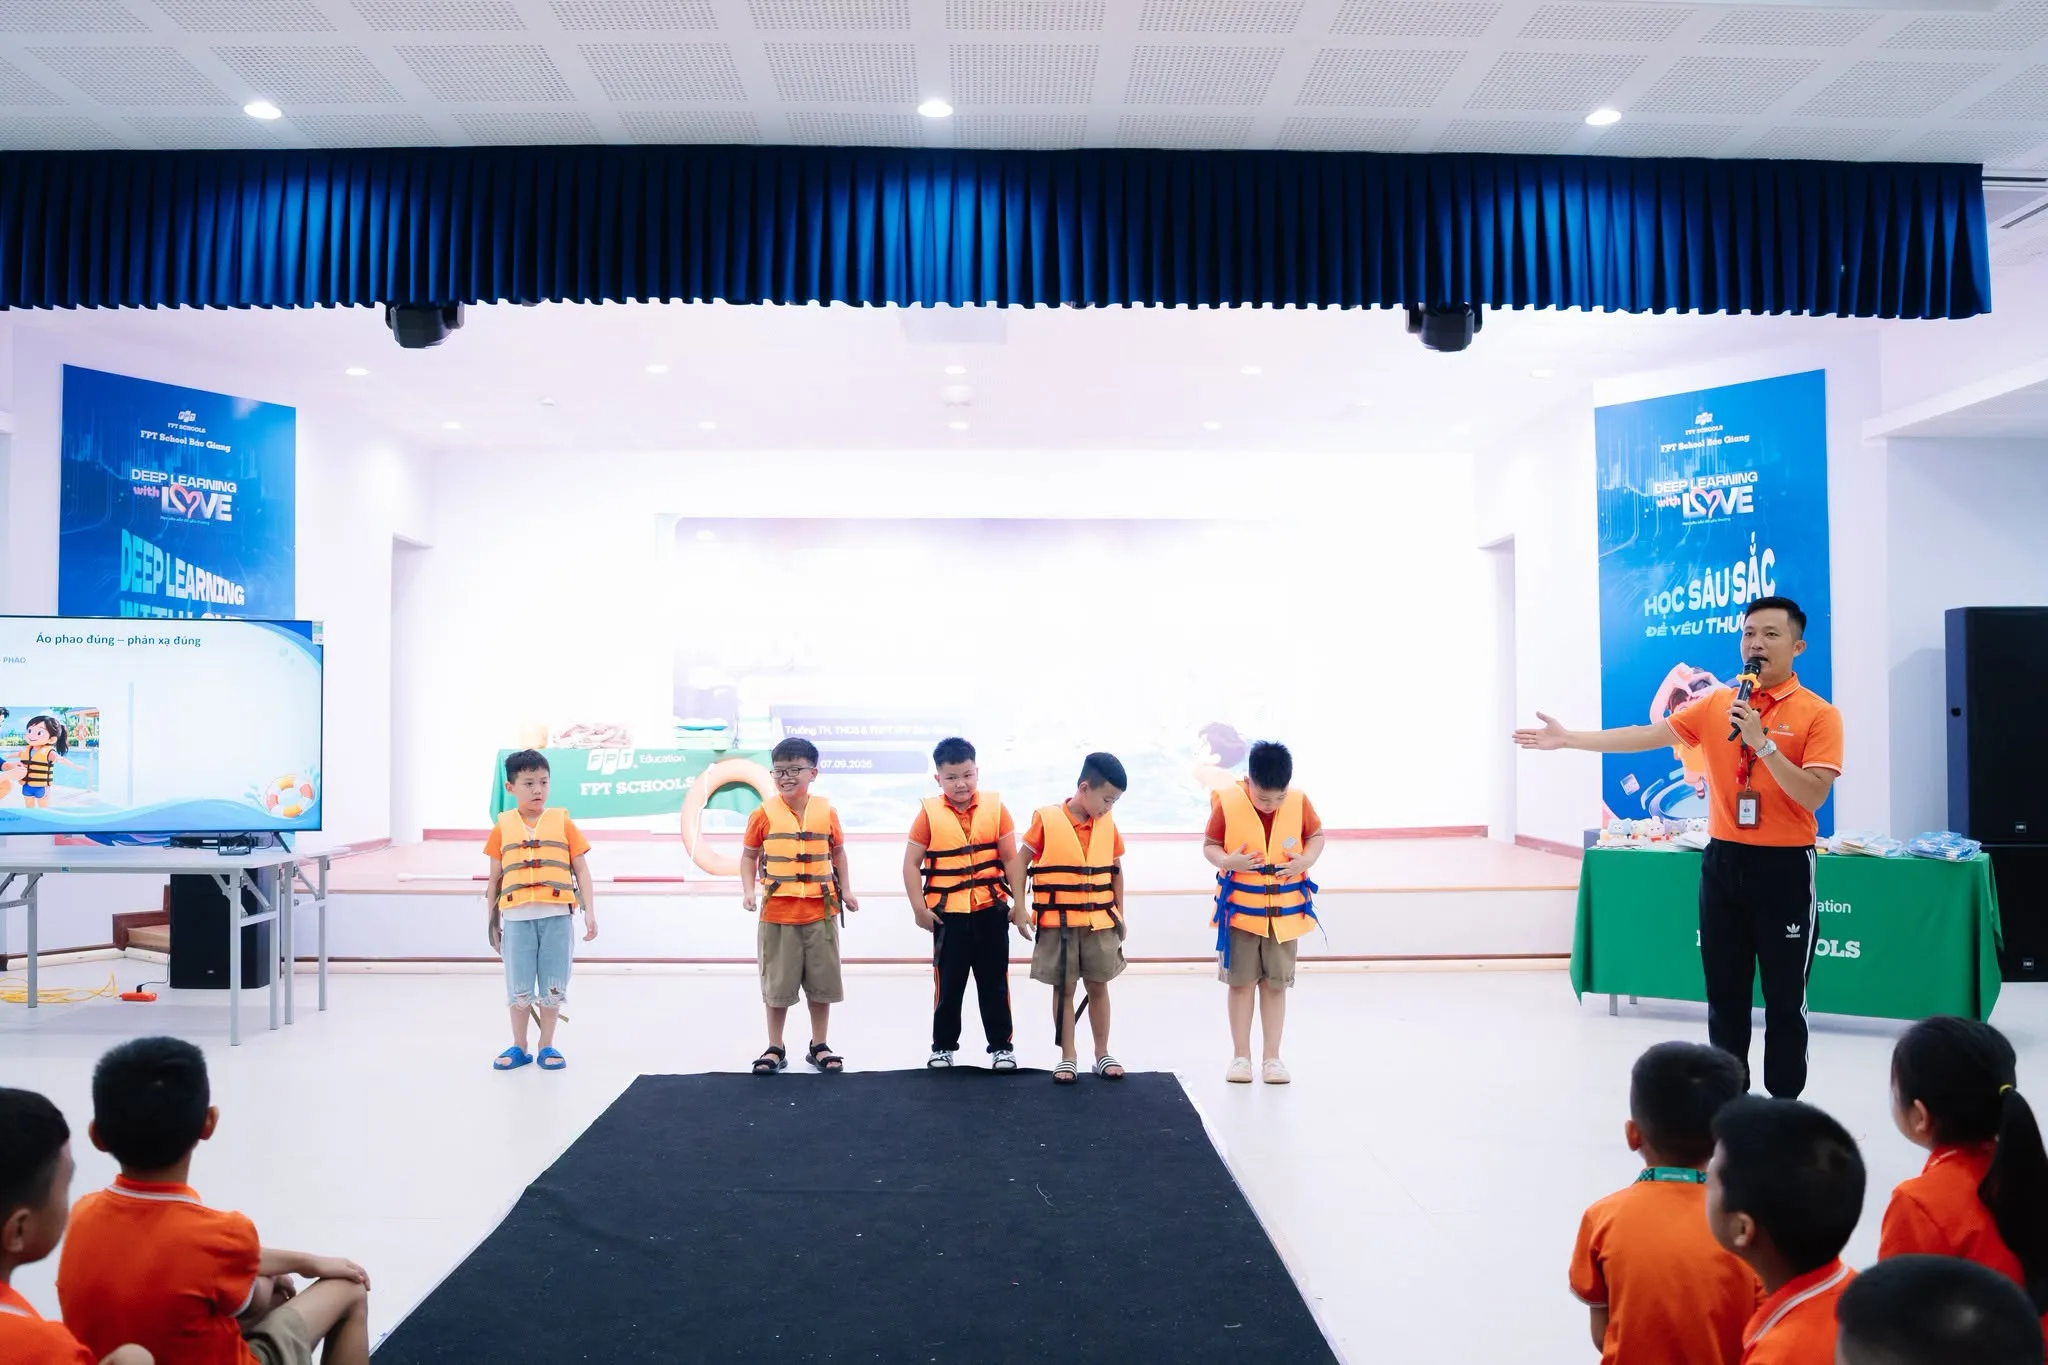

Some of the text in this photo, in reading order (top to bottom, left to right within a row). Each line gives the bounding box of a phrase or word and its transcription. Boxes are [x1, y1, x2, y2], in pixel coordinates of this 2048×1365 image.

[140, 430, 158, 440] FPT
[159, 433, 187, 445] School
[206, 440, 231, 453] Giang
[1660, 443, 1677, 453] FPT
[1678, 439, 1706, 451] School
[1724, 434, 1750, 444] Giang
[131, 468, 237, 494] DEEP LEARNING
[133, 485, 160, 498] with
[1654, 471, 1758, 494] DEEP LEARNING
[1656, 495, 1681, 508] with
[120, 528, 245, 606] DEEP LEARNING
[1644, 531, 1776, 620] HỌC SÂU SẮC
[1645, 620, 1667, 637] ĐỂ
[1670, 618, 1704, 636] YÊU
[36, 632, 52, 644] Áo
[55, 634, 84, 646] phao
[86, 634, 115, 647] đúng
[127, 634, 155, 647] phản
[158, 637, 171, 647] xạ
[173, 634, 201, 648] đúng
[587, 748, 686, 776] FPT Education
[580, 775, 696, 796] FPT SCHOOLS
[1817, 899, 1851, 914] ation
